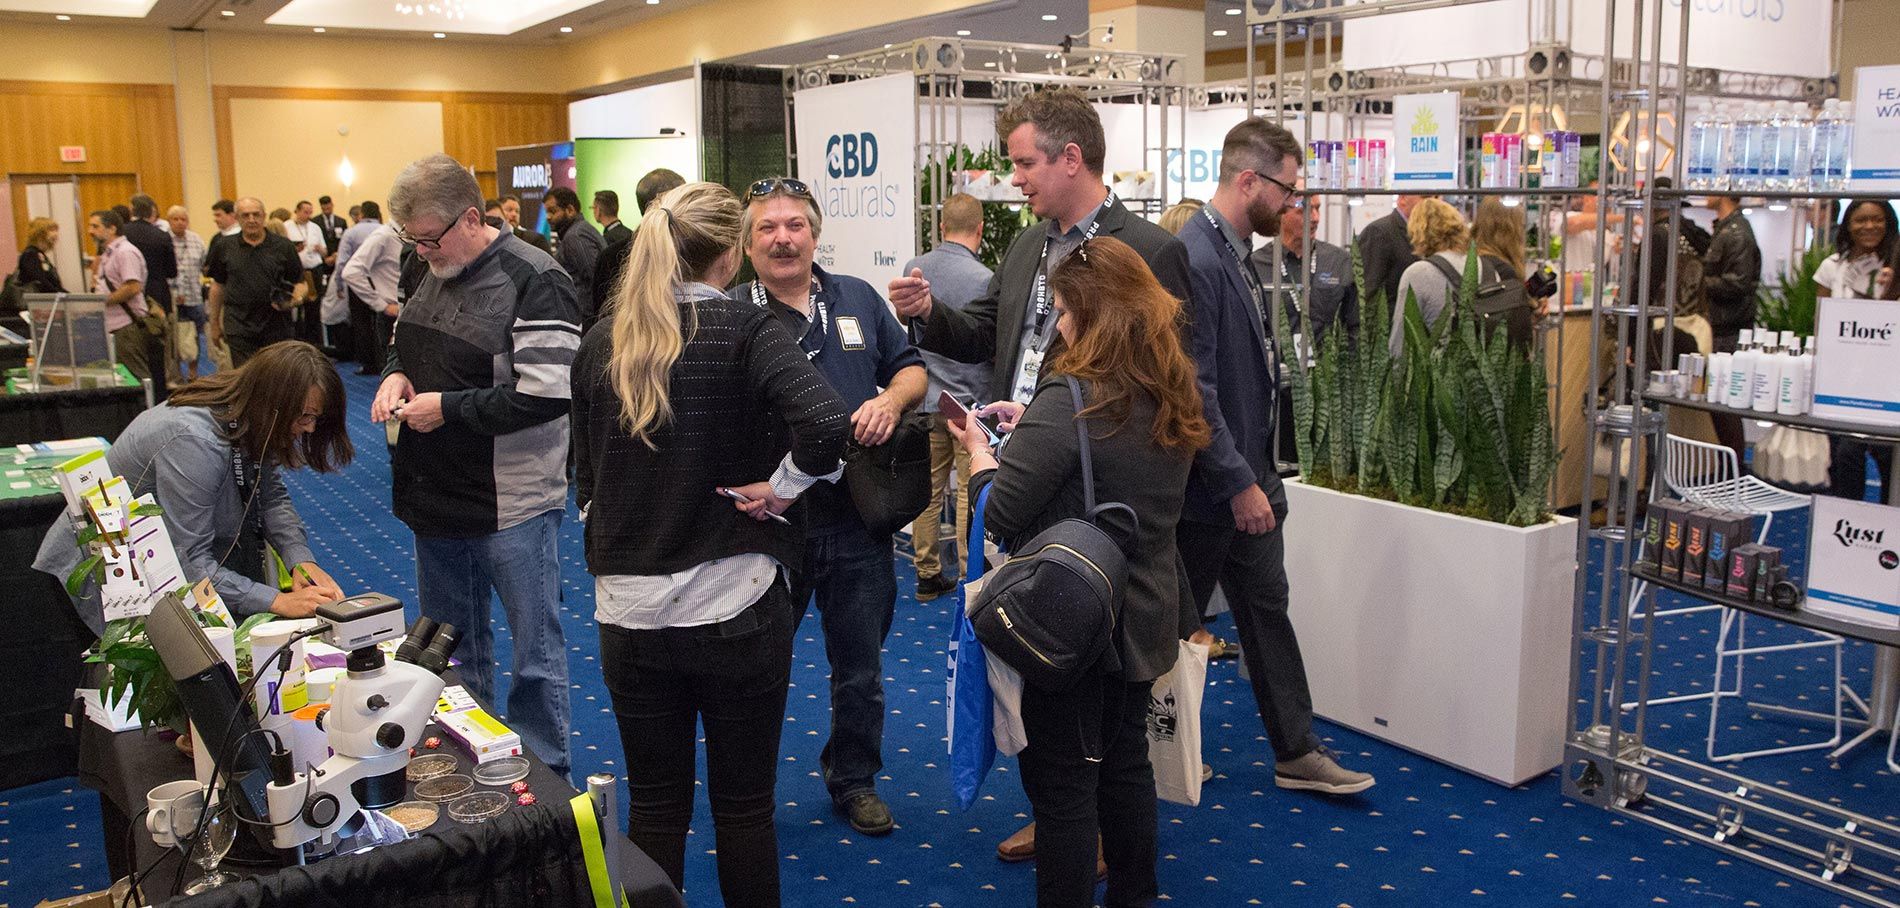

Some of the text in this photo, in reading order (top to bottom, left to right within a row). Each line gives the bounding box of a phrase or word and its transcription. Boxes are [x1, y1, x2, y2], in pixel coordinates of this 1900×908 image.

[826, 132, 878, 179] CBD
[1411, 136, 1439, 153] RAIN
[1838, 320, 1892, 341] Floré
[1833, 518, 1885, 547] Lust
